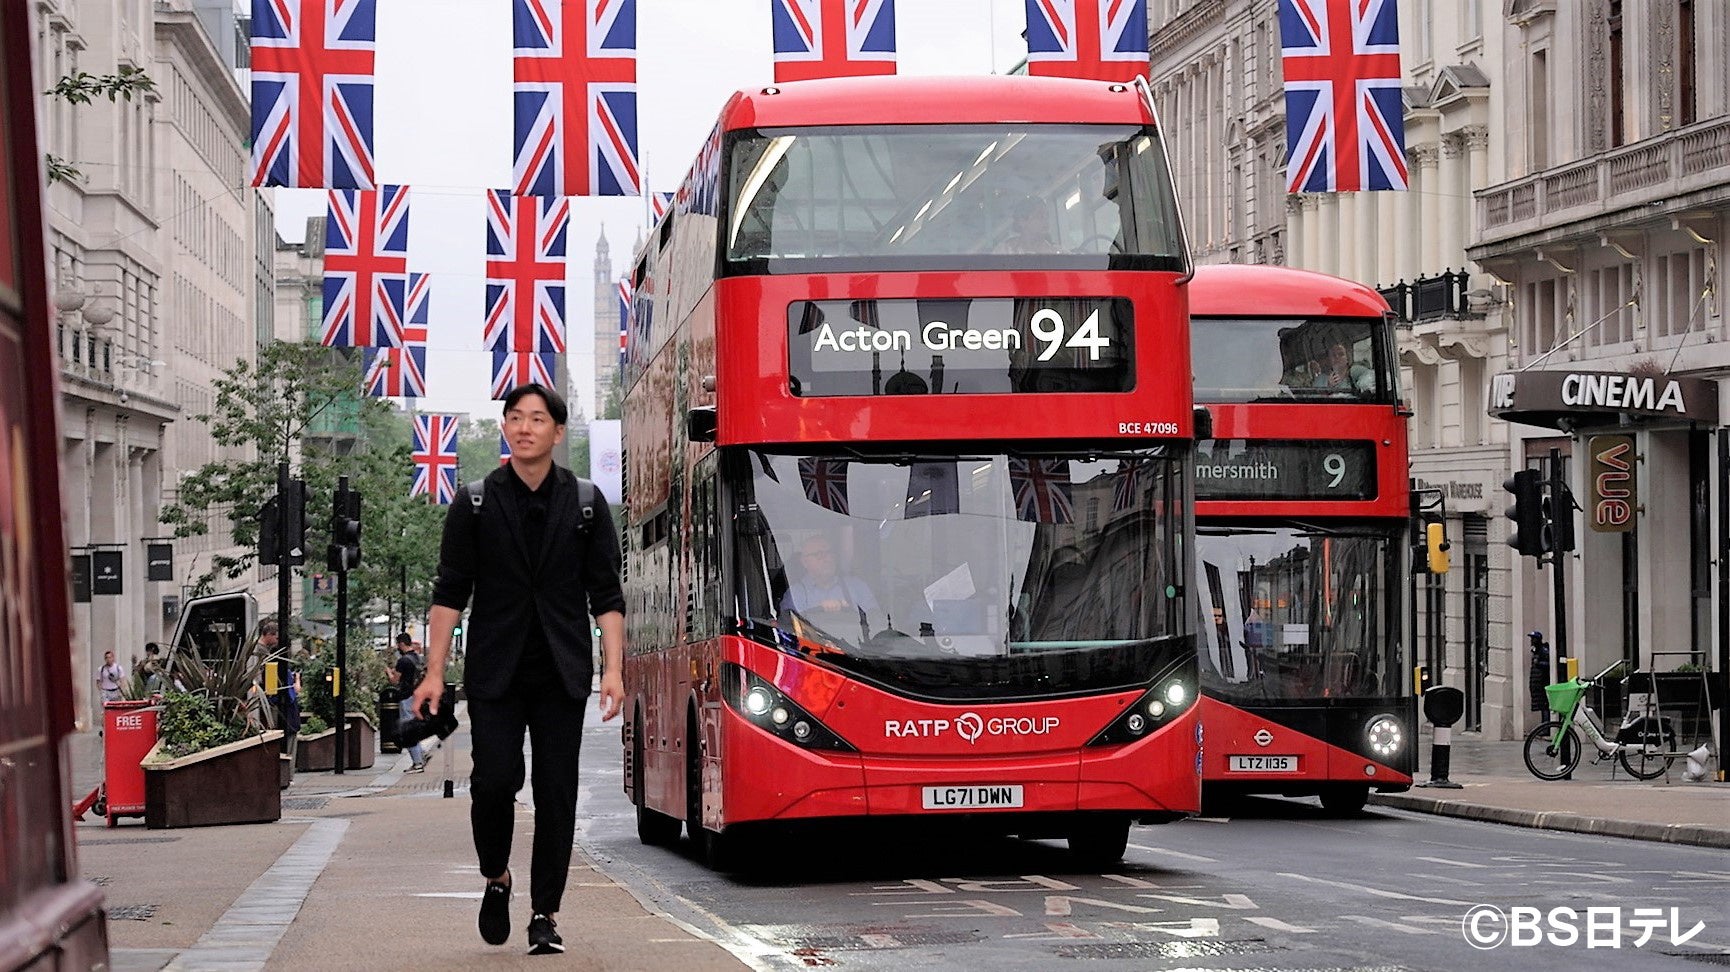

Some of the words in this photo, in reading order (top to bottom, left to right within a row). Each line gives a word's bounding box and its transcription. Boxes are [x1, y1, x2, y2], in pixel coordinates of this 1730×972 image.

[814, 323, 911, 351] Acton
[922, 321, 1021, 350] Green
[1030, 308, 1110, 361] 94
[1562, 373, 1686, 413] CINEMA
[1118, 423, 1141, 434] BCE
[1143, 423, 1178, 434] 47096
[1323, 453, 1346, 488] 9
[116, 715, 142, 726] FREE
[885, 719, 949, 737] RATP
[987, 717, 1060, 735] GROUP
[1239, 757, 1262, 769] LTZ
[1265, 757, 1288, 769] 1135
[933, 789, 973, 805] LG71
[978, 788, 1012, 804] DWN
